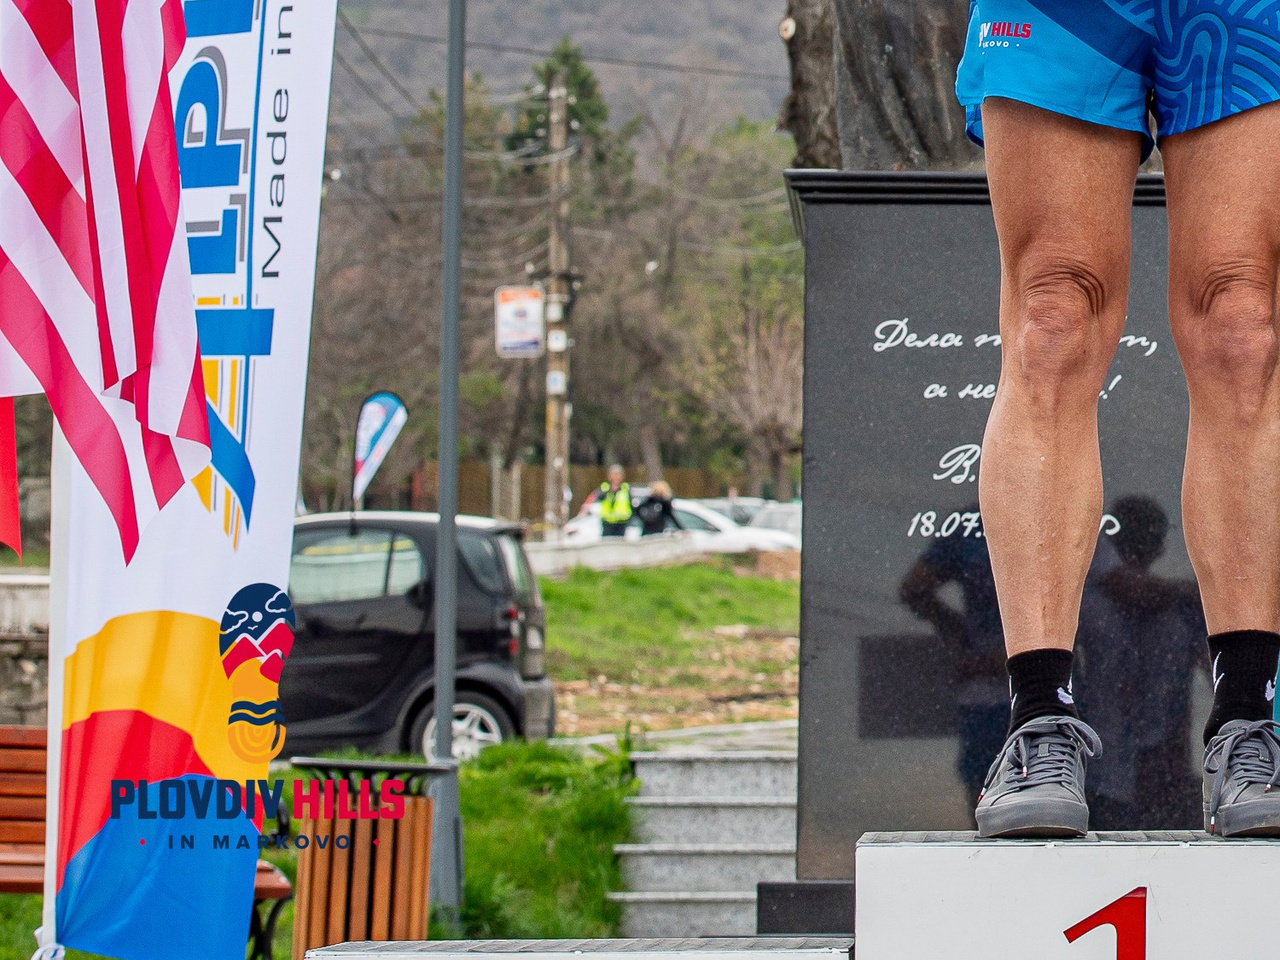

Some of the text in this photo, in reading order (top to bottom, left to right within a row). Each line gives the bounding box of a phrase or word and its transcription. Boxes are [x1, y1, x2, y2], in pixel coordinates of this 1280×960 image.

[272, 4, 294, 56] in
[990, 21, 1032, 39] HILLS
[262, 88, 290, 279] Made
[873, 317, 963, 353] Дела
[923, 382, 948, 399] а
[906, 510, 987, 539] 18.07.
[1062, 886, 1147, 960] 1
